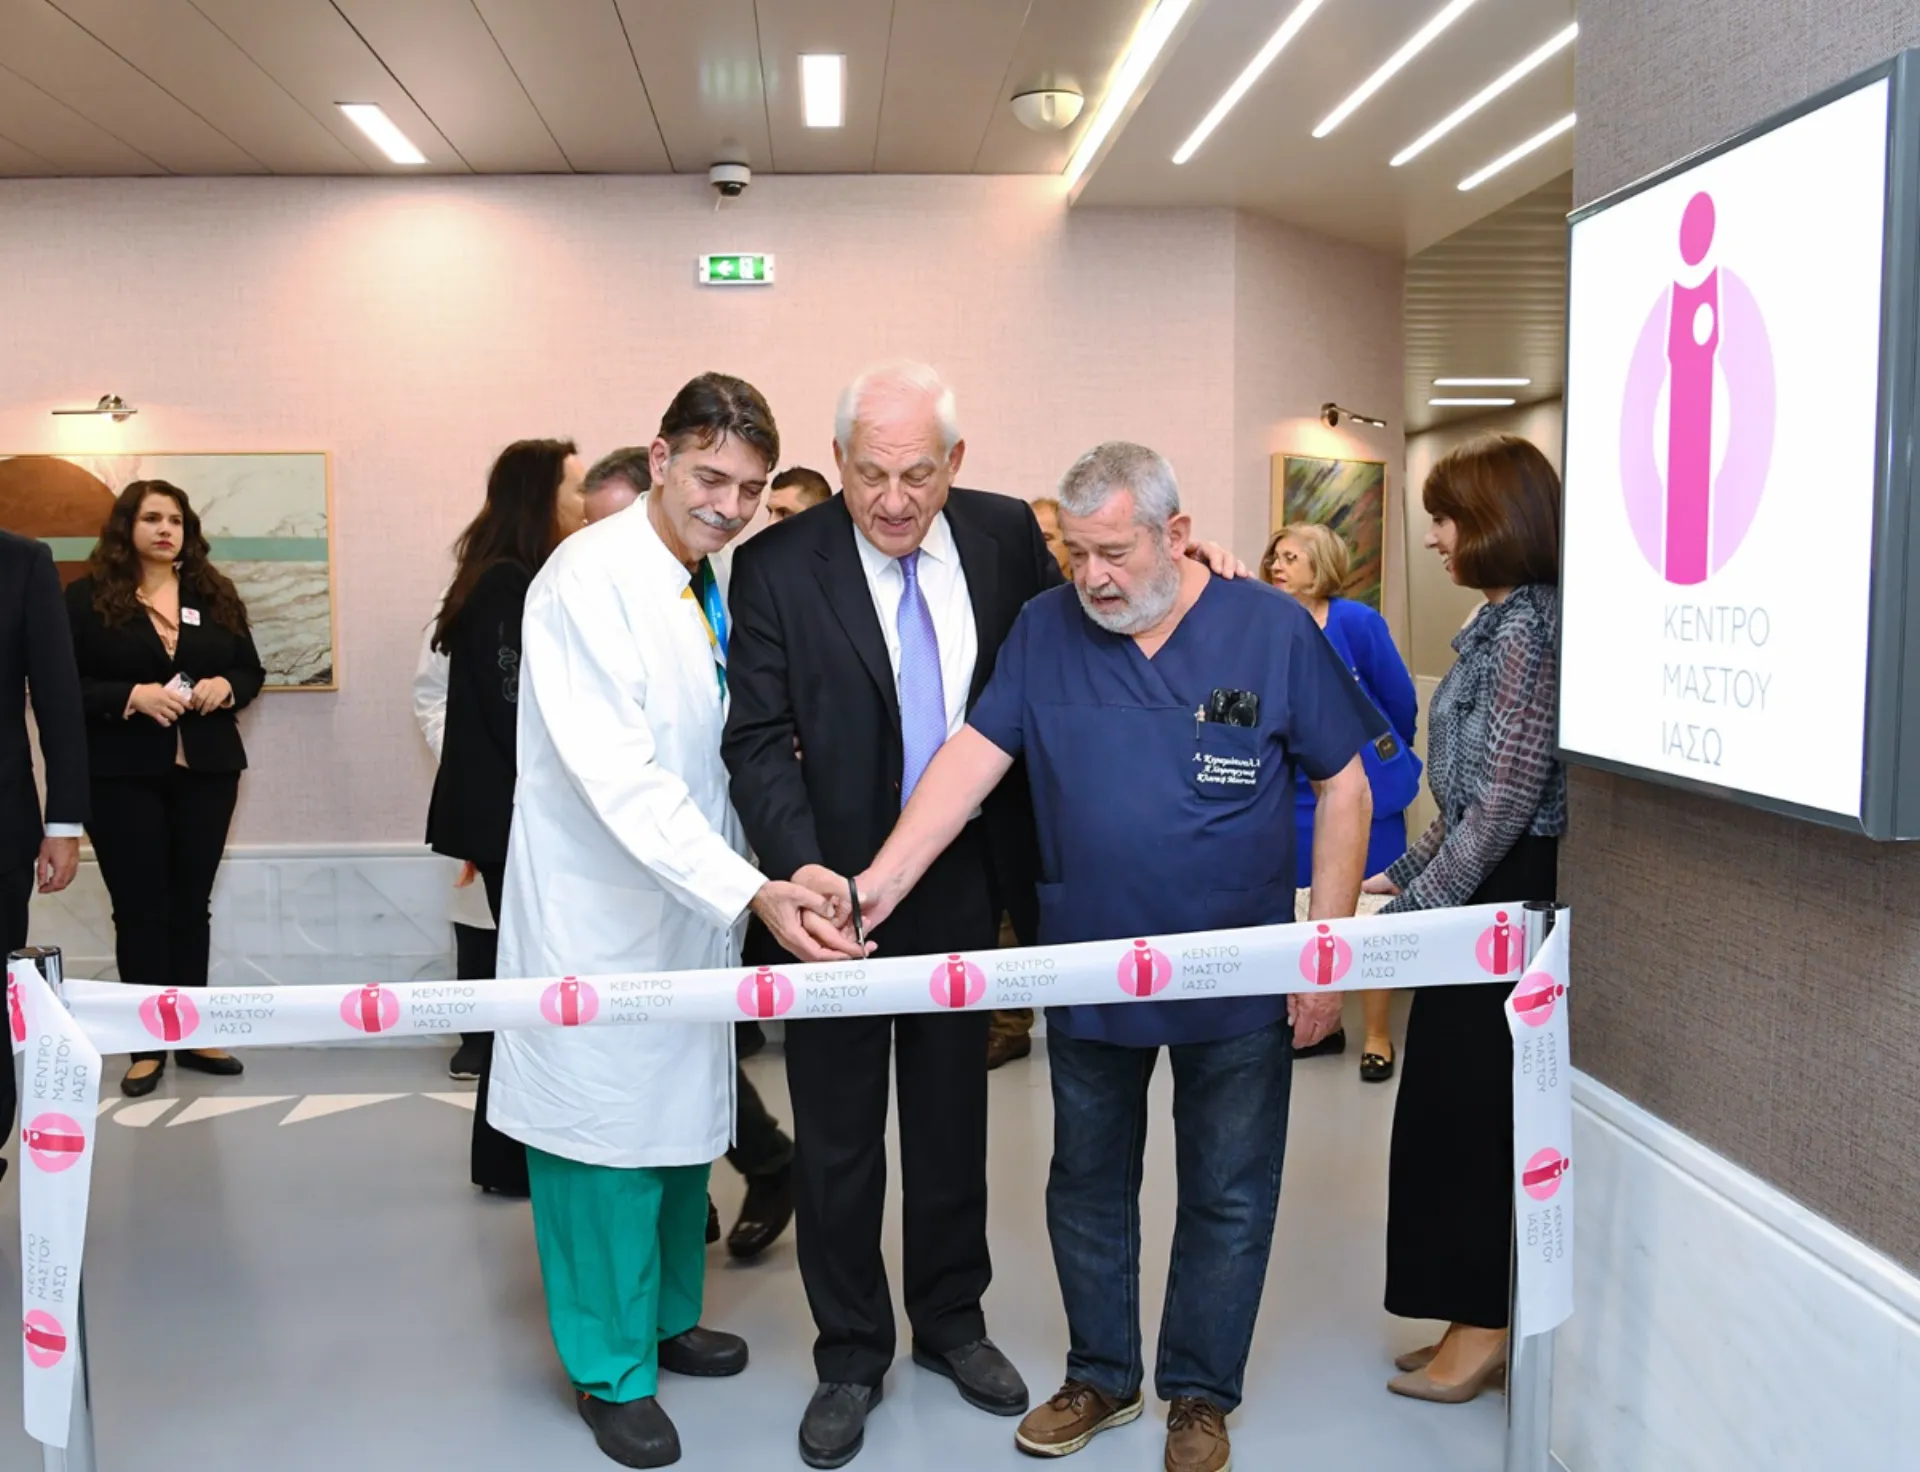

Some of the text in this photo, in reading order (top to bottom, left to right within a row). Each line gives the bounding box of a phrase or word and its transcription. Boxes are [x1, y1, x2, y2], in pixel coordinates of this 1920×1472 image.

[1664, 604, 1770, 647] ΚΕΝΤΡΟ
[1663, 663, 1772, 711] ΜΑΣΤΟΥ
[1662, 720, 1722, 766] ΙΑΣΩ
[1363, 934, 1419, 949] ΚΕΝΤΡΟ
[1181, 945, 1240, 960] ΚΕΝΤΡΟ
[1362, 949, 1419, 964] ΜΑΣΤΟΥ
[996, 958, 1055, 972] ΚΕΝΤΡΟ
[1182, 961, 1242, 976] ΜΑΣΤΟΥ
[1361, 965, 1396, 980] ΙΑΣΩ
[805, 969, 866, 983] ΚΕΝΤΡΟ
[996, 974, 1058, 989] ΜΑΣΤΟΥ
[610, 979, 673, 992] ΚΕΝΤΡΟ
[1182, 977, 1217, 991] ΙΑΣΩ
[209, 993, 274, 1006] ΚΕΝΤΡΟ
[411, 988, 475, 1000] ΚΕΝΤΡΟ
[806, 985, 868, 999] ΜΑΣΤΟΥ
[996, 991, 1033, 1003] ΙΑΣΩ
[411, 1002, 476, 1015] ΜΑΣΤΟΥ
[610, 995, 675, 1009] ΜΑΣΤΟΥ
[806, 1003, 843, 1014] ΙΑΣΩ
[210, 1009, 276, 1020] ΜΑΣΤΟΥ
[611, 1012, 650, 1023] ΙΑΣΩ
[213, 1022, 253, 1035] ΙΑΣΩ
[412, 1018, 452, 1030] ΙΑΣΩ
[1522, 1039, 1533, 1075] ΙΑΣΩ
[1536, 1035, 1547, 1093] ΜΑΣΤΟΥ
[1547, 1031, 1558, 1088] ΚΕΝΤΡΟ
[33, 1034, 53, 1100] ΚΕΝΤΡΟ
[51, 1034, 73, 1102] ΜΑΣΤΟΥ
[71, 1064, 88, 1103] ΙΑΣΩ
[1527, 1213, 1539, 1246] ΙΑΣΩ
[1542, 1208, 1554, 1264] ΜΑΣΤΟΥ
[37, 1235, 51, 1300] ΜΑΣΤΟΥ
[53, 1264, 68, 1303] ΙΑΣΩ
